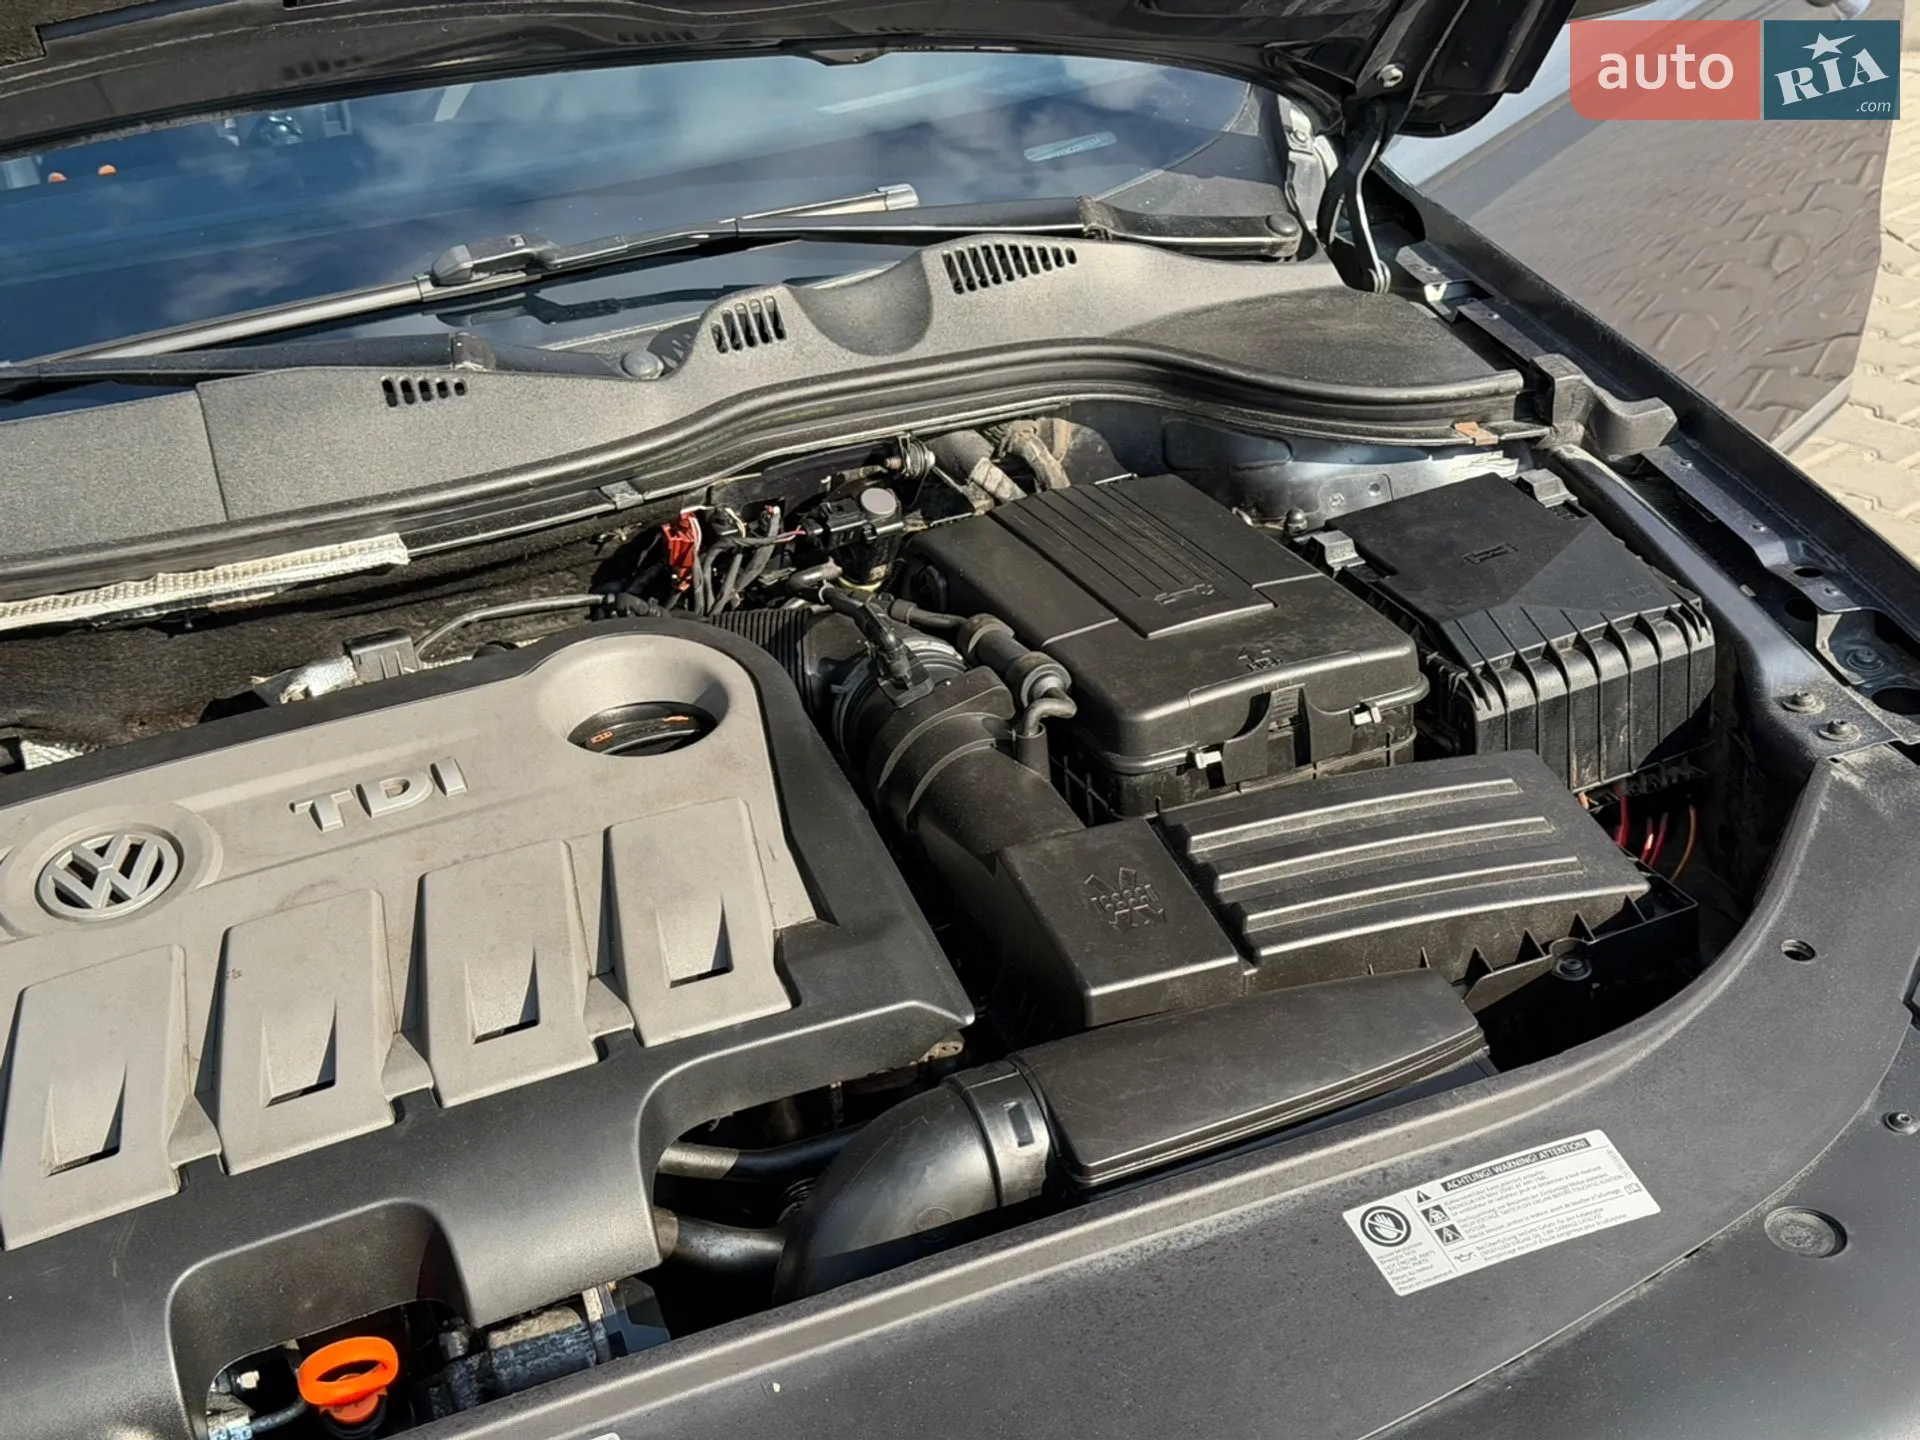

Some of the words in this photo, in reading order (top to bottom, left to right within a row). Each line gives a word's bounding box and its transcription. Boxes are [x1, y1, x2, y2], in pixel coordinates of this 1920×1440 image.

[290, 756, 468, 832] TDI
[1445, 1168, 1493, 1190] ACHTUNG!
[1492, 1154, 1539, 1175] WARNING!
